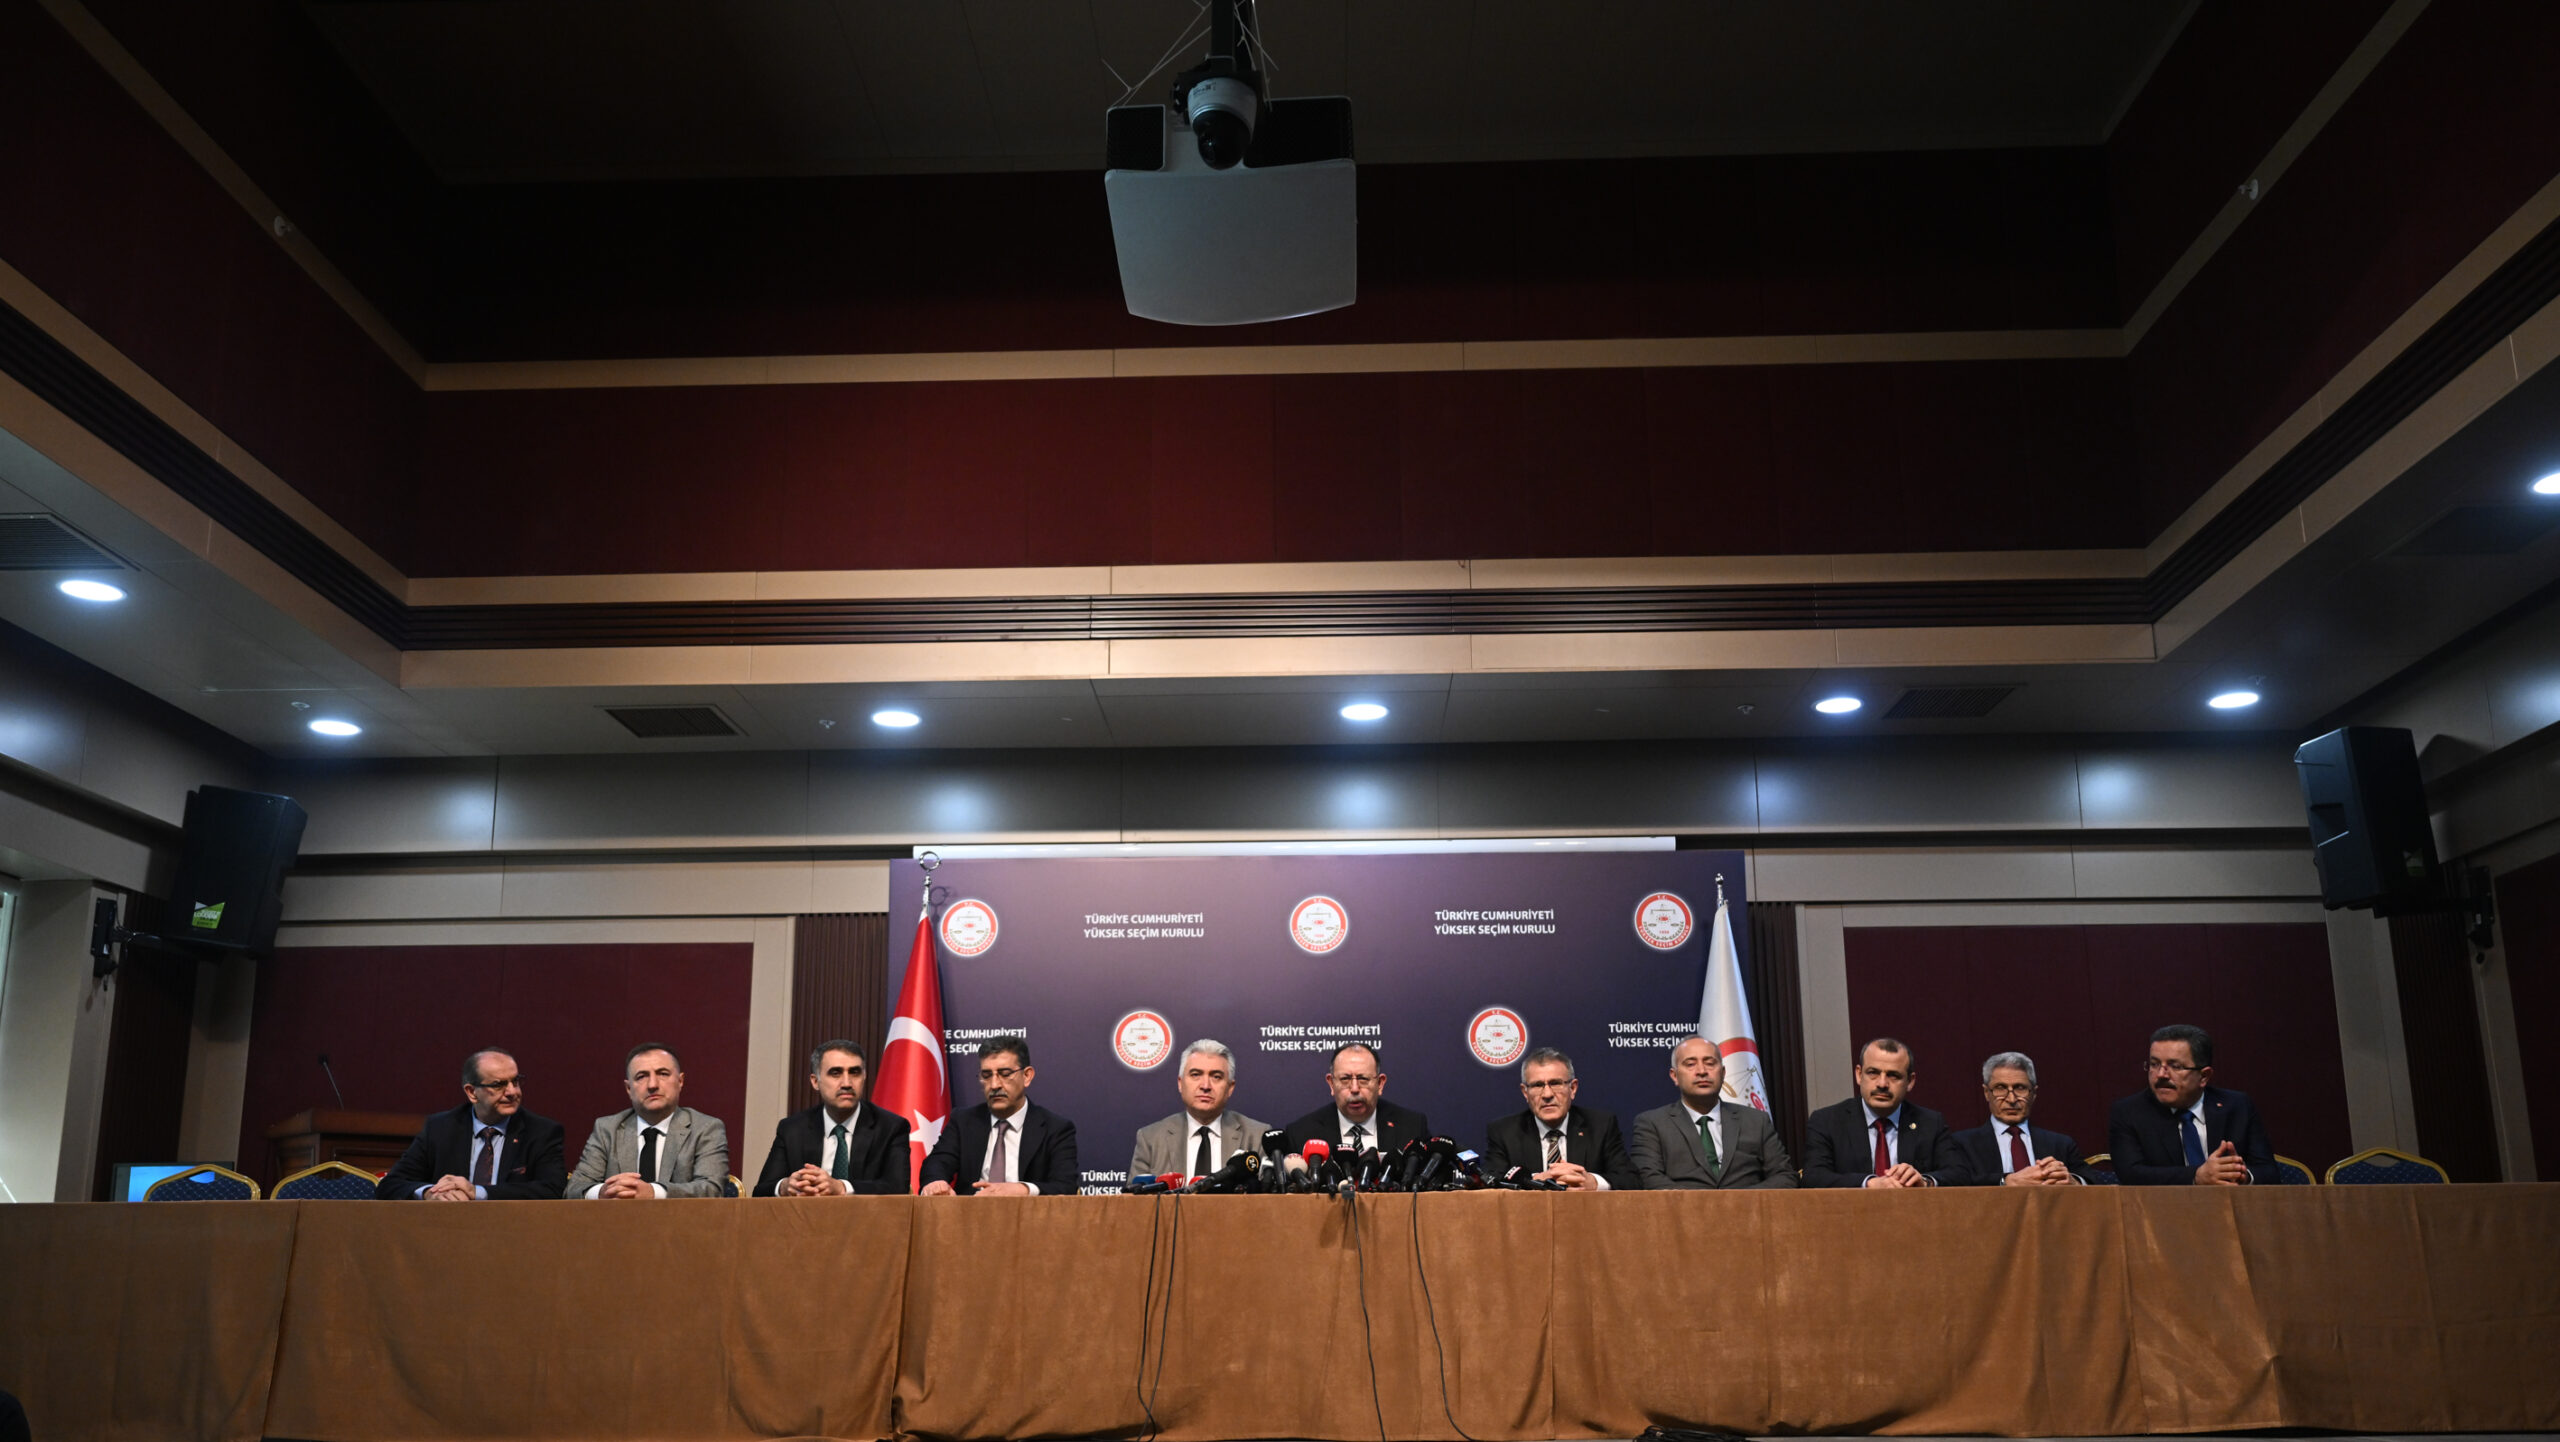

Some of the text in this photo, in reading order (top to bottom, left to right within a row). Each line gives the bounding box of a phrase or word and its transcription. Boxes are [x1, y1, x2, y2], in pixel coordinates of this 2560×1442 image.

[1084, 912, 1203, 924] TÜRKİYE CUMHURİYETİ
[1435, 908, 1554, 921] TÜRKİYE CUMHURİYETİ
[1083, 926, 1204, 940] YÜKSEK SEÇİM KURULU
[1434, 923, 1555, 936] YÜKSEK SEÇİM KURULU
[1260, 1024, 1380, 1037] TÜRKİYE CUMHURİYETİ
[1608, 1021, 1698, 1033] TÜRKİYE CUMHU
[1259, 1039, 1301, 1051] YÜKSEK
[1303, 1039, 1336, 1052] SEÇİM
[1608, 1036, 1650, 1048] YÜKSEK
[1081, 1169, 1127, 1182] TÜRKİYE
[1080, 1185, 1122, 1196] YÜKSEK
